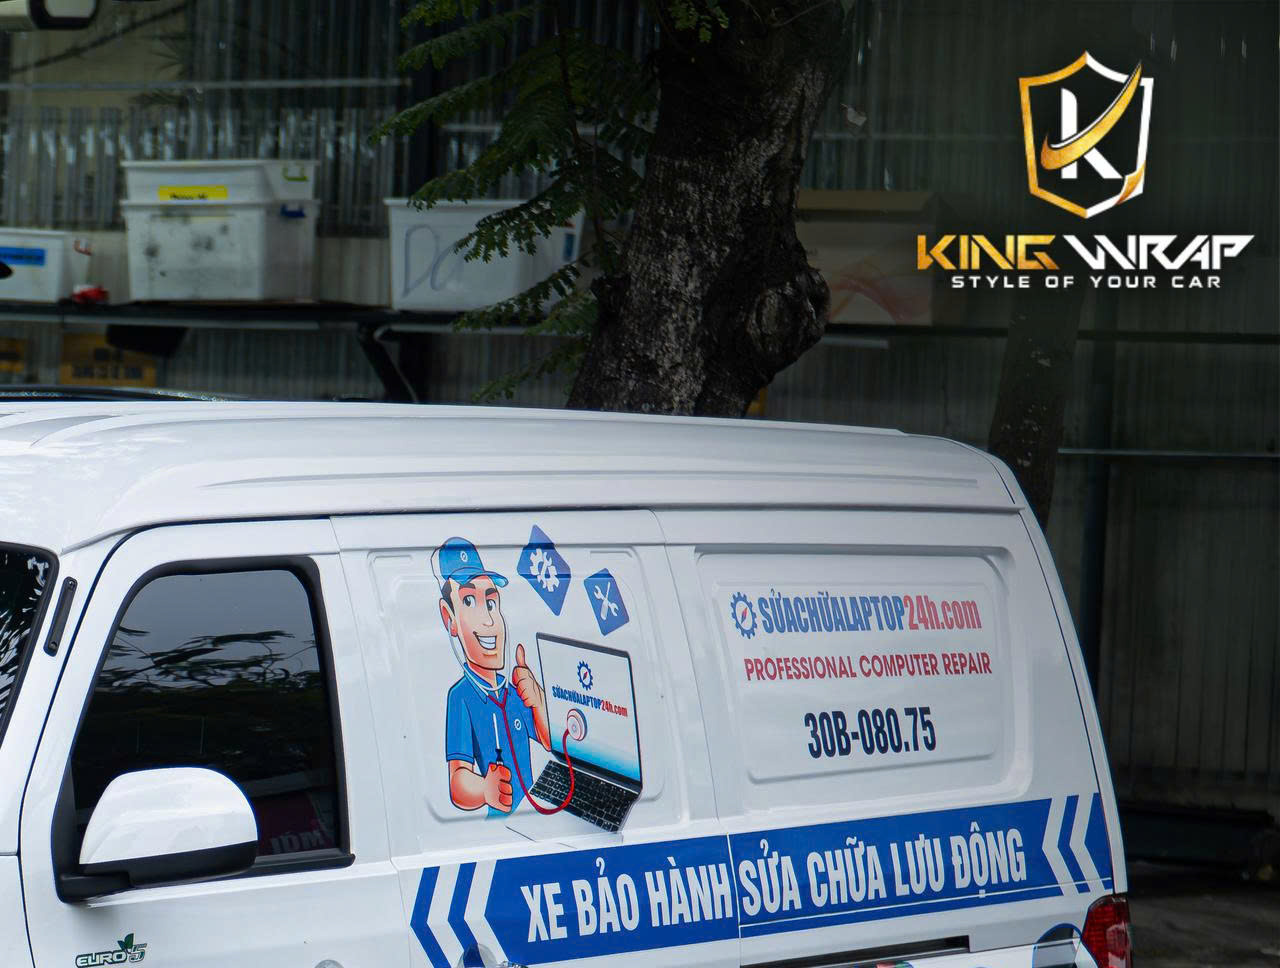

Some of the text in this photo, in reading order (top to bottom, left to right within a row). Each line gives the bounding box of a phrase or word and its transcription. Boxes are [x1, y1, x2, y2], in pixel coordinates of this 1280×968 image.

[744, 652, 993, 681] PROFESSIONAL COMPUTER REPAIR
[804, 706, 937, 759] 30B-080.75
[520, 821, 1027, 943] XE BẢO HÀNH SỬA CHỮA LƯU ĐỘNG
[75, 950, 127, 968] EURO
